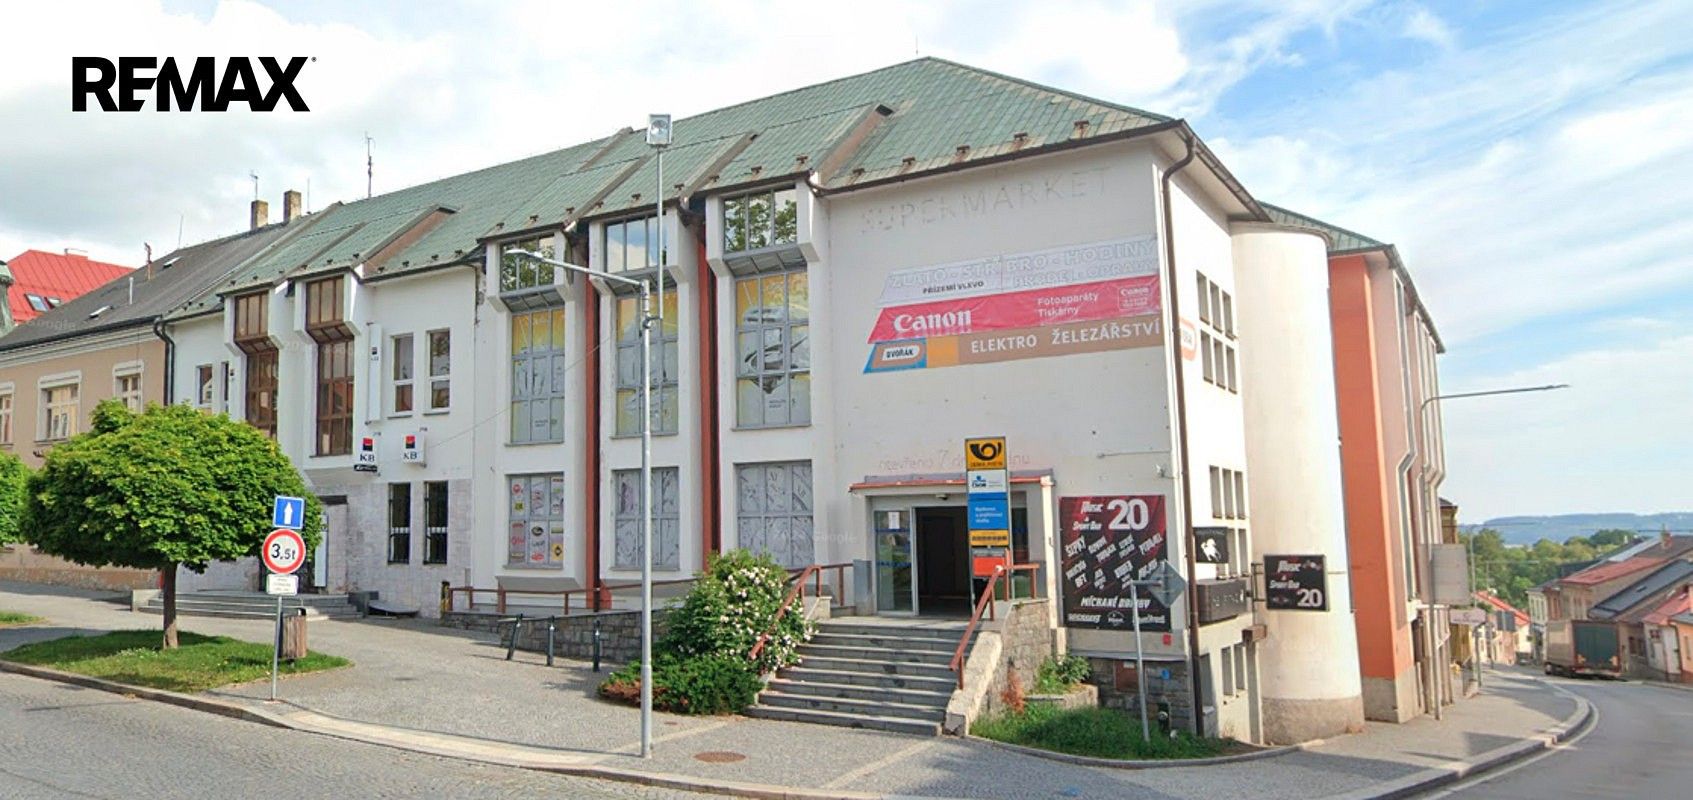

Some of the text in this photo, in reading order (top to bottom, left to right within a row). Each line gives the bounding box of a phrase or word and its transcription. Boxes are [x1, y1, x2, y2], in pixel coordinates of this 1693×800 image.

[958, 280, 985, 290] VLEVO
[1037, 291, 1099, 306] Fotoaparáty
[1038, 305, 1080, 318] Tiskárny
[894, 310, 971, 332] Canon
[971, 335, 1038, 354] ELEKTRO
[1051, 318, 1160, 345] ŽELEZÁŘSTVÍ
[360, 454, 375, 463] KB
[404, 451, 417, 461] KB
[1108, 499, 1149, 530] 20
[1297, 588, 1322, 607] 20
